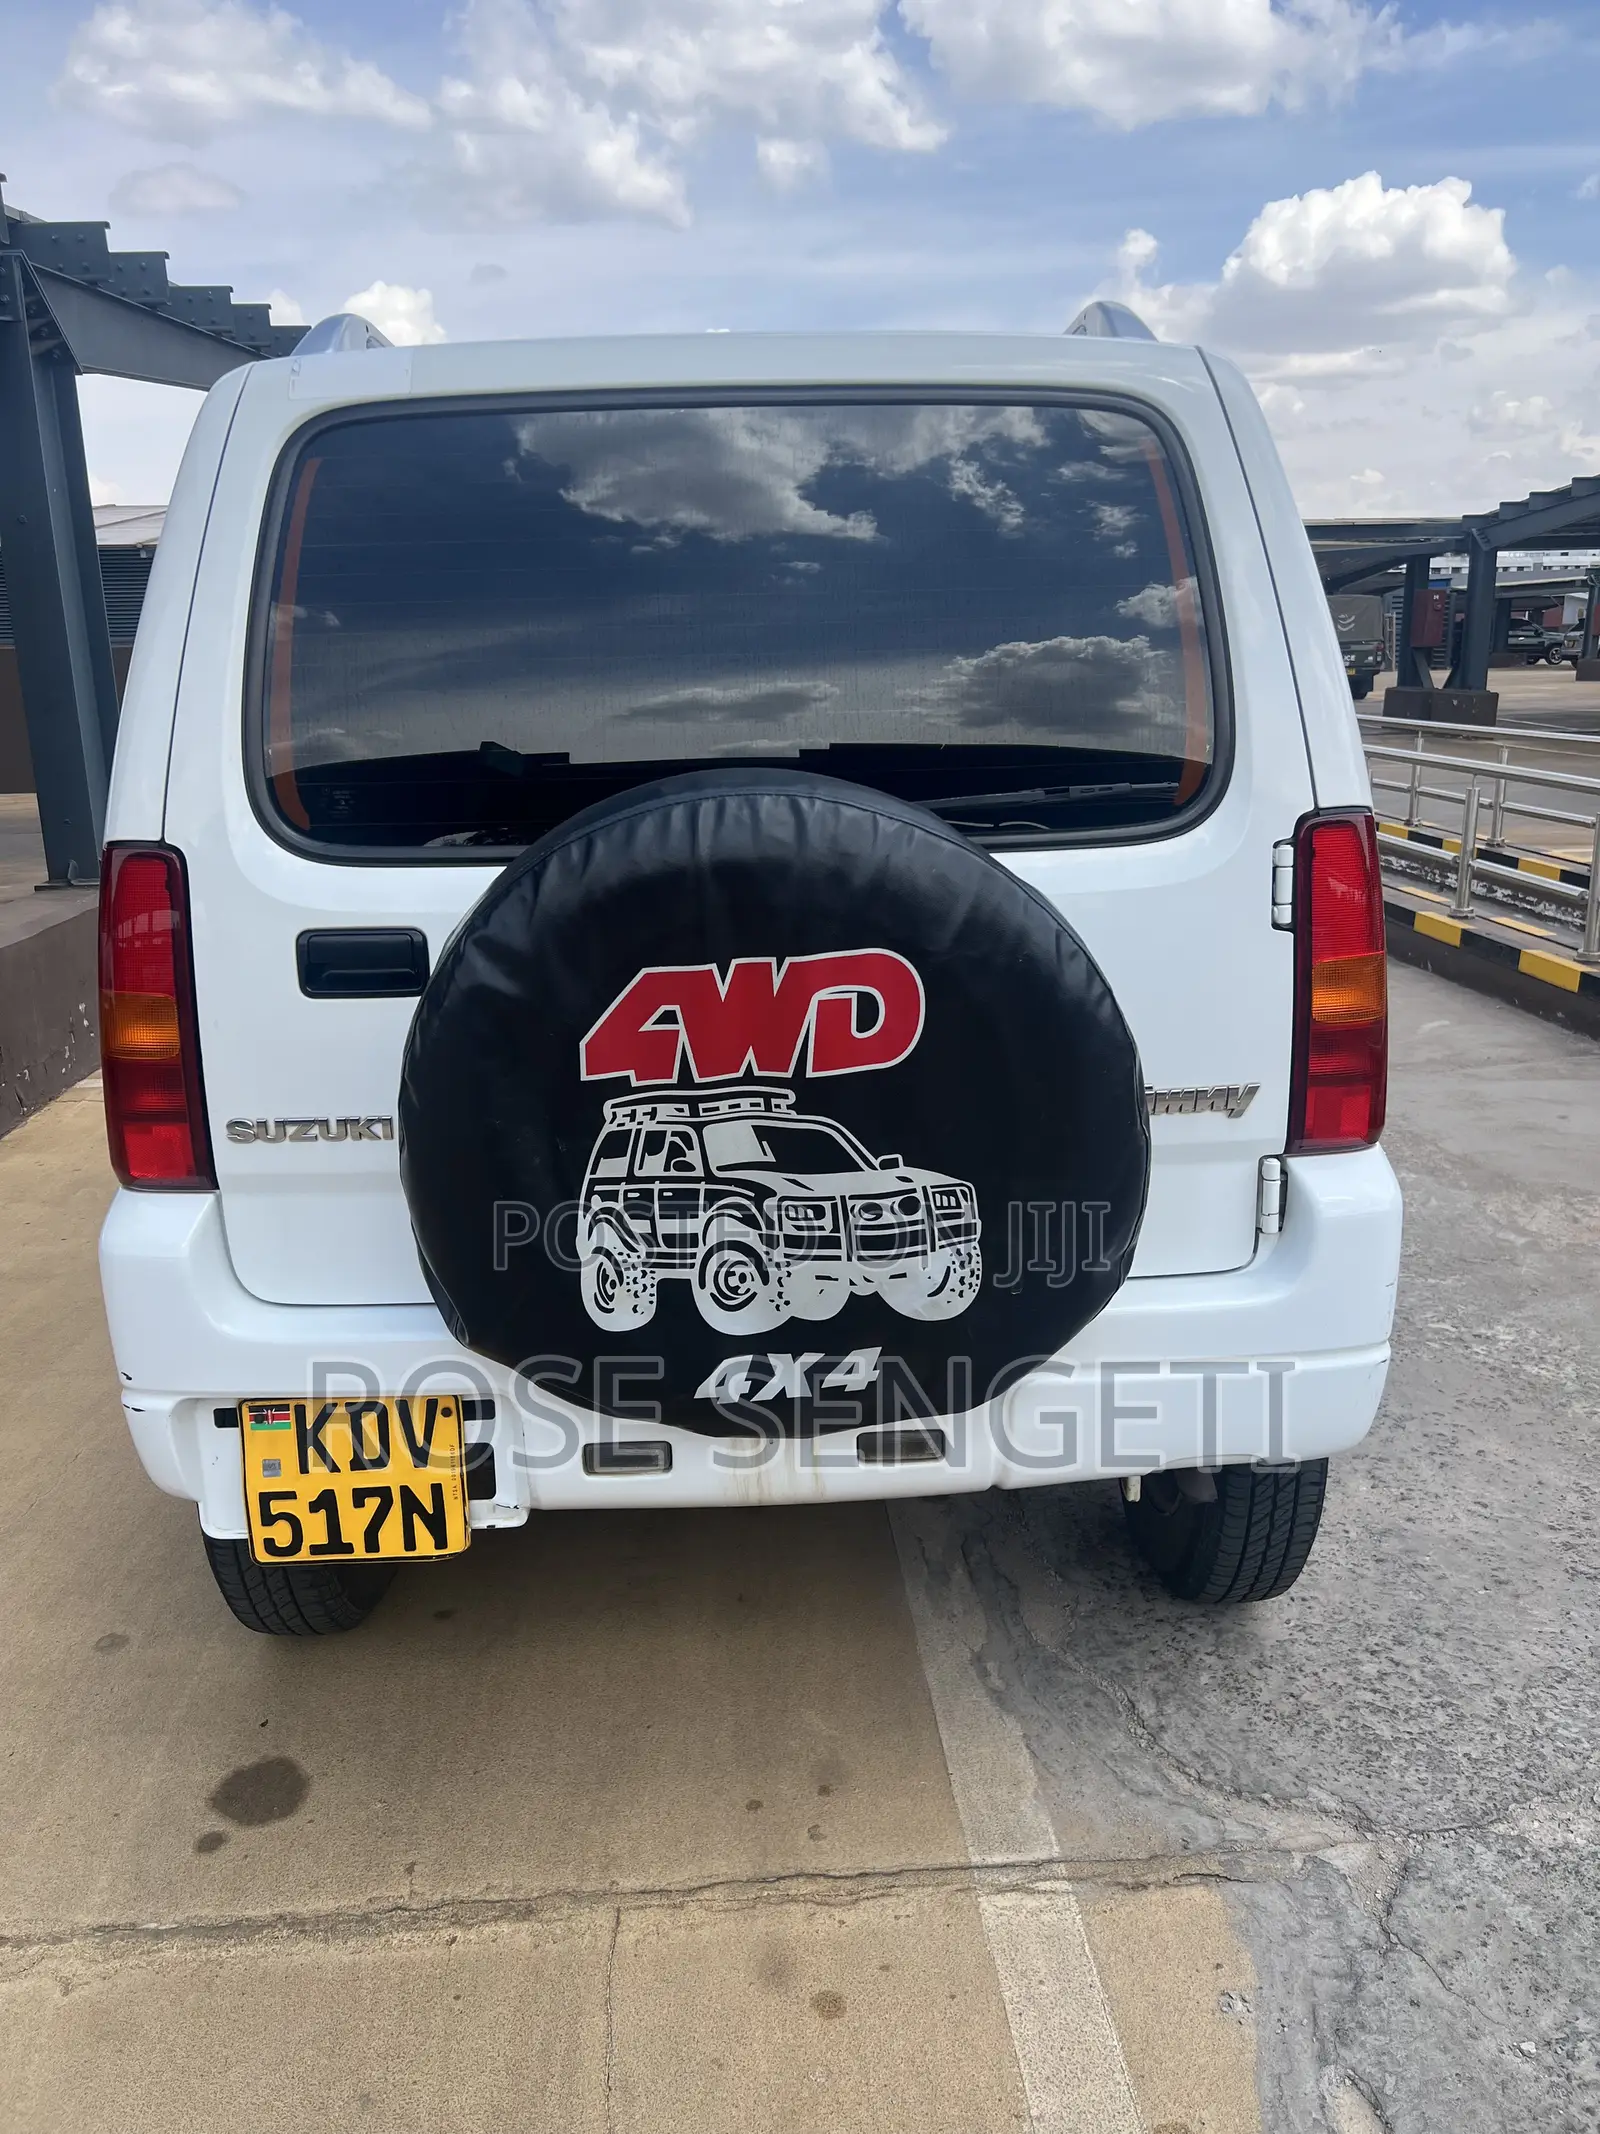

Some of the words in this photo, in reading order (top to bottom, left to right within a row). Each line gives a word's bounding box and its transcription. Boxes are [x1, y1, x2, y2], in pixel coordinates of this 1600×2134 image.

[579, 947, 926, 1087] 4WD
[225, 1115, 395, 1144] SUZUKI
[1144, 1082, 1261, 1118] imny
[294, 1398, 439, 1474] KDV
[258, 1482, 448, 1557] 517N
